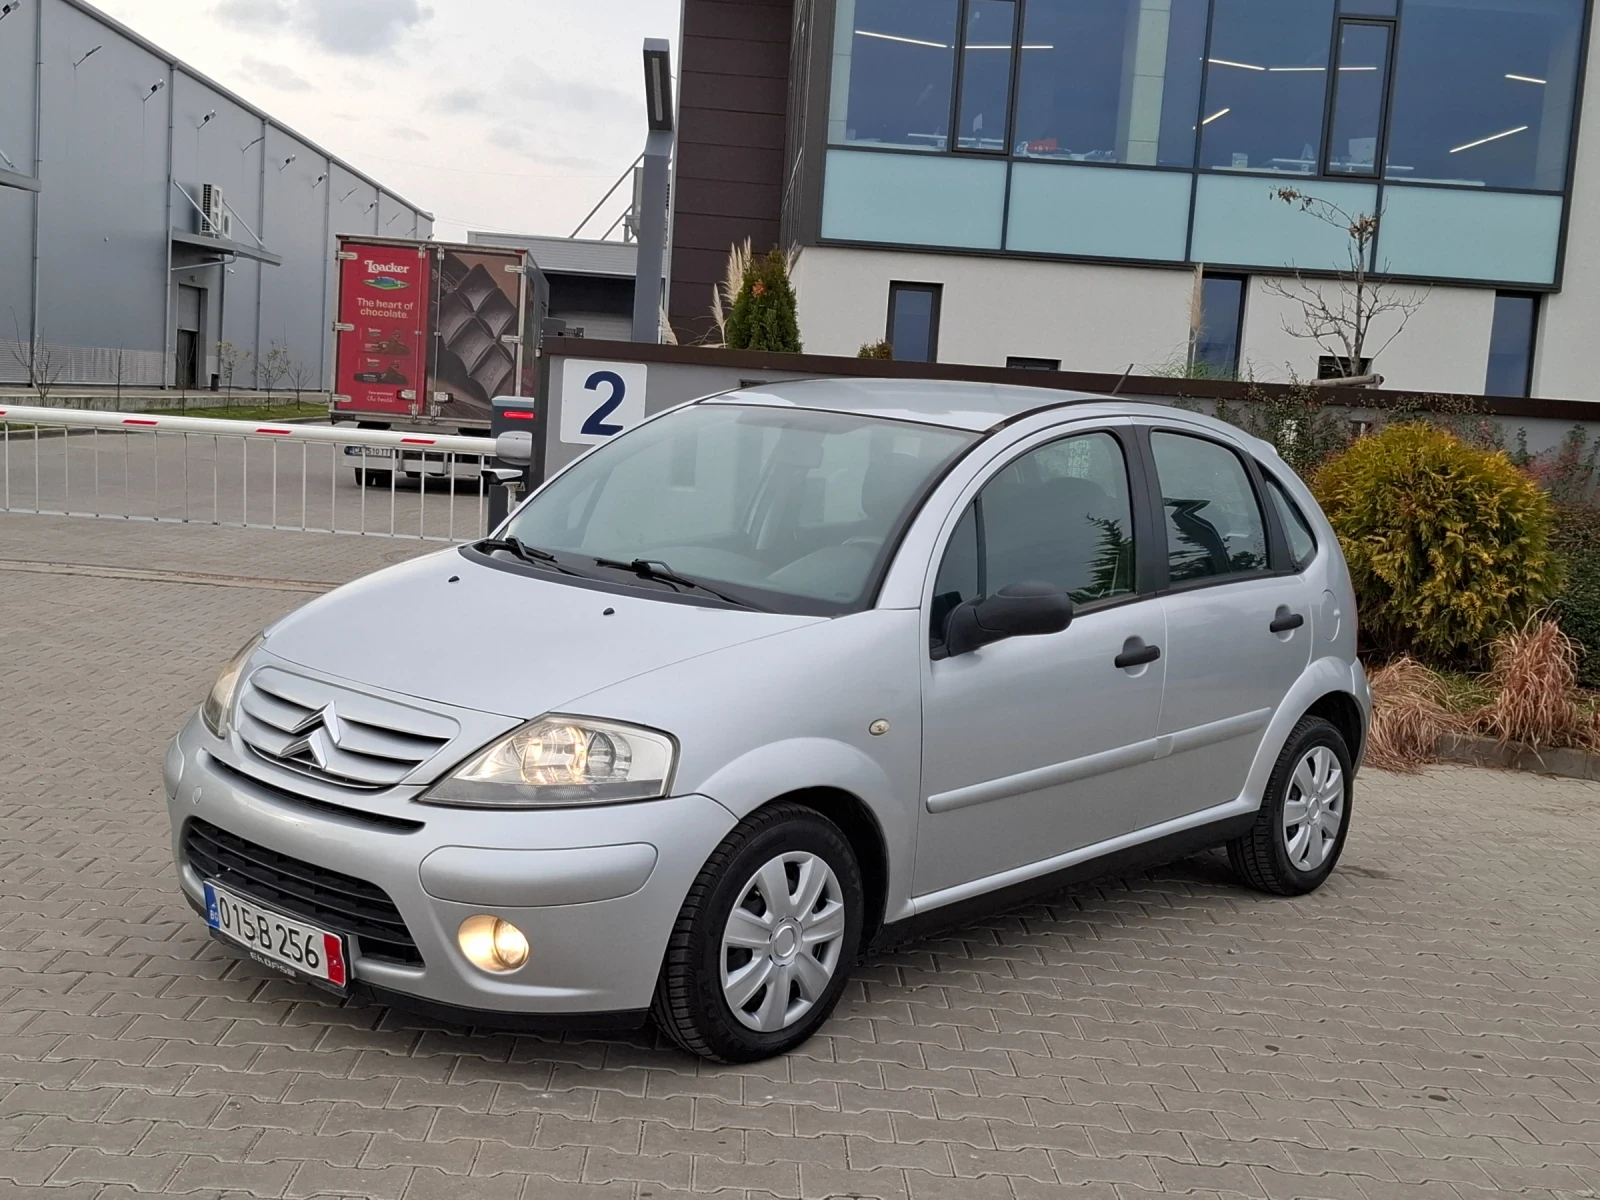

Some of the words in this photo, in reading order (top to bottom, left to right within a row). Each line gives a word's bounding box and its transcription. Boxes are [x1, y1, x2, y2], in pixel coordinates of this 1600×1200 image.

[364, 259, 410, 274] Loacker
[356, 297, 375, 307] The
[376, 299, 402, 310] heart
[403, 301, 414, 310] of
[360, 307, 409, 319] chocolate.
[580, 370, 626, 436] 2
